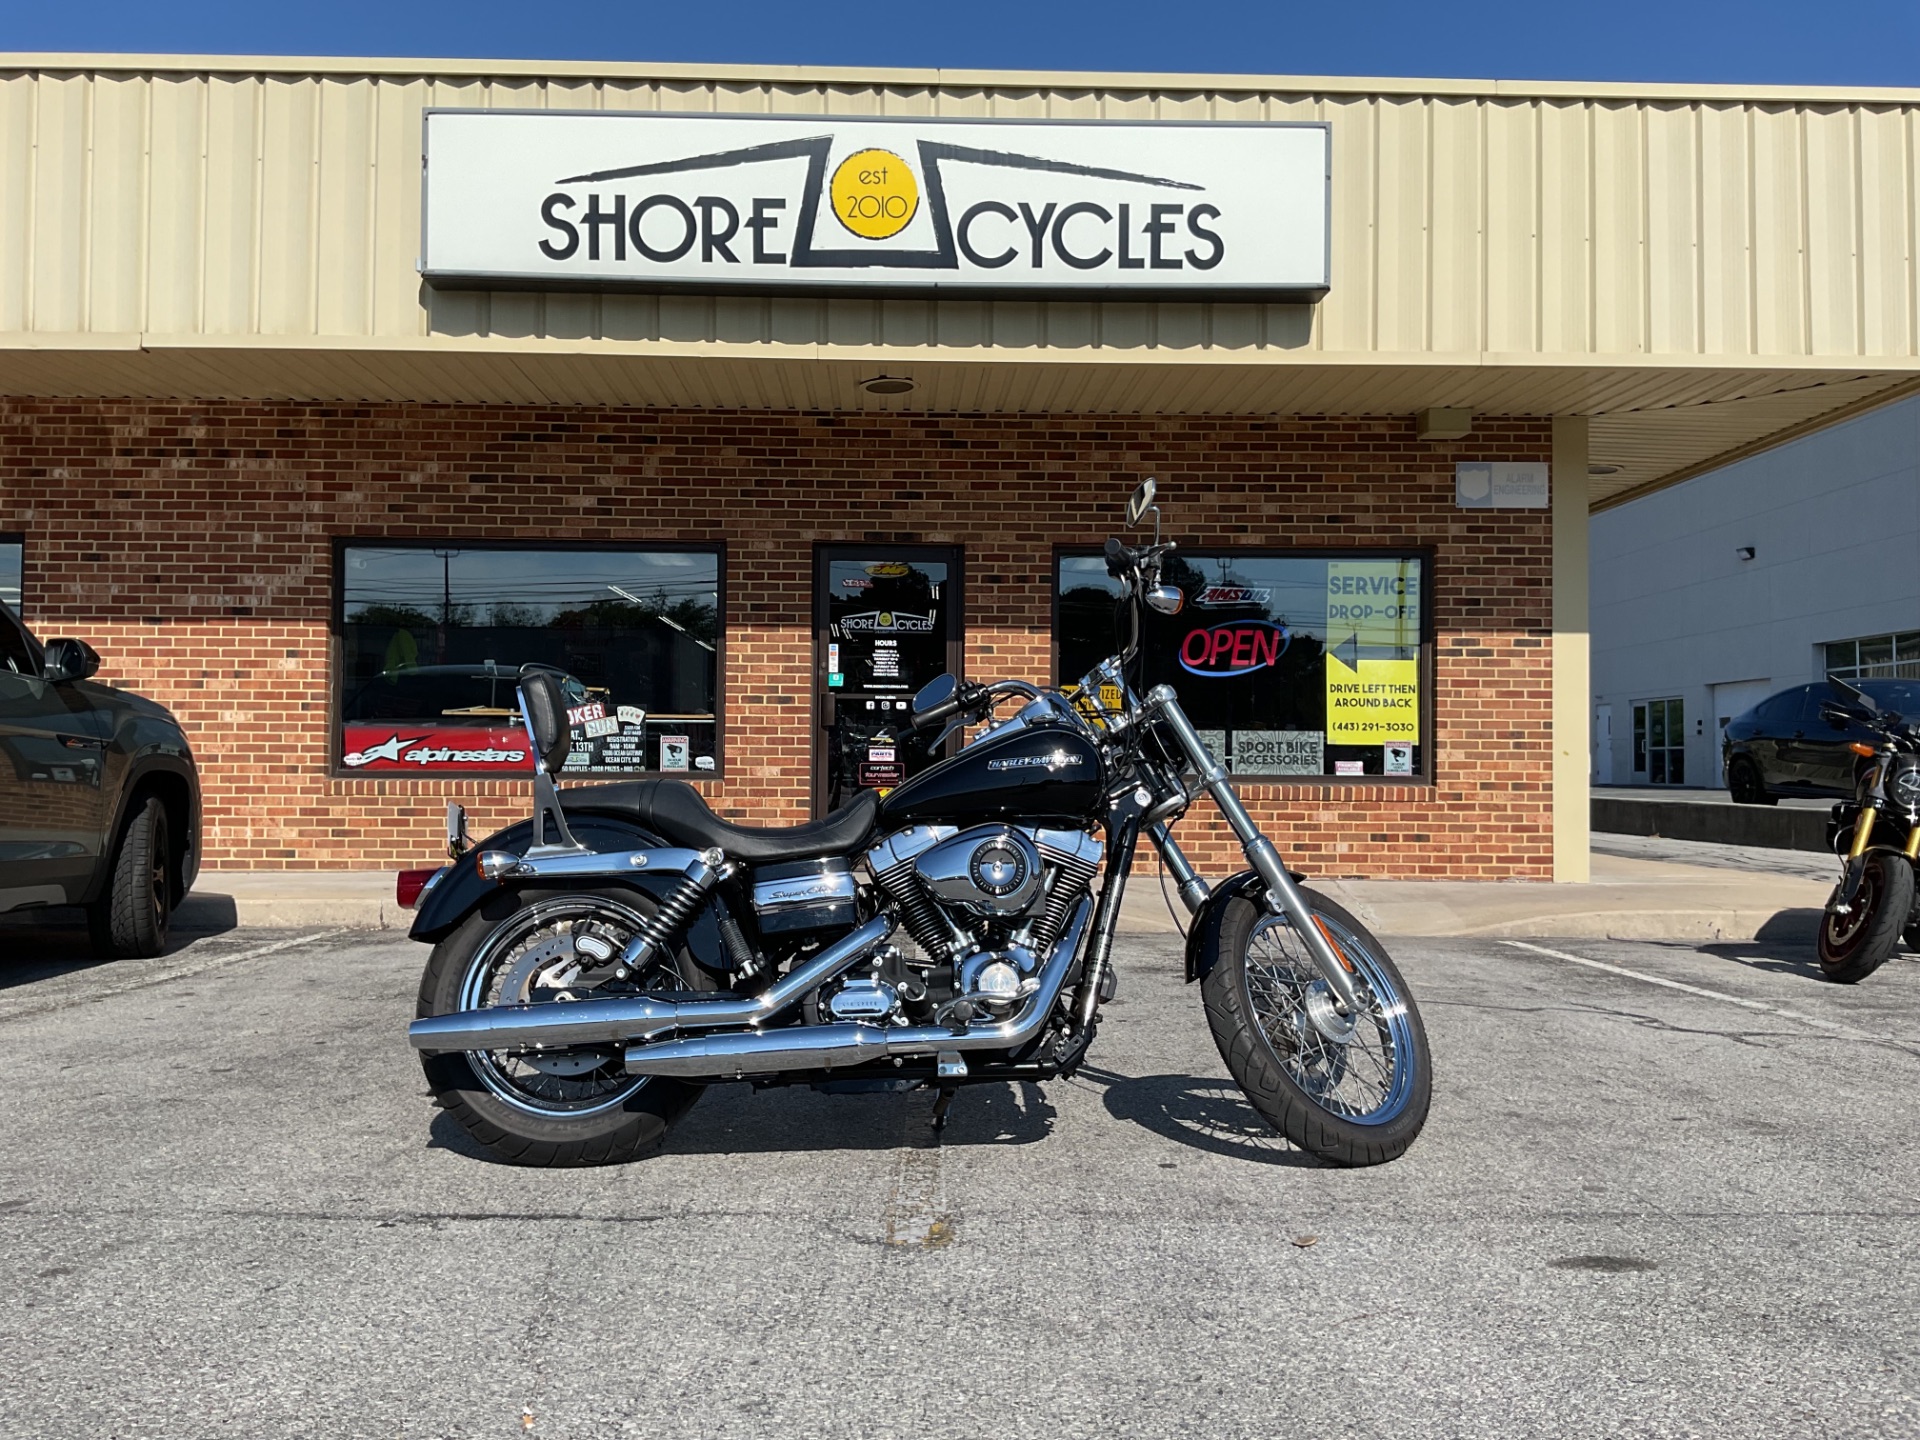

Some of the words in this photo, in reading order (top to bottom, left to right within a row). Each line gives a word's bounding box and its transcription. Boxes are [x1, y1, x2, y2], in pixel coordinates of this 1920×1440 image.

[858, 167, 887, 185] est
[847, 195, 908, 219] 2010
[538, 192, 787, 264] SHORE
[956, 201, 1225, 270] CYCLES
[1505, 473, 1534, 484] ALARM
[1493, 484, 1546, 495] ENGINEERING
[1329, 576, 1418, 595] SERVICE
[1202, 588, 1269, 601] AMSOIL
[1329, 604, 1417, 619] DROP-OFF
[841, 619, 874, 629] SHORE
[897, 620, 933, 630] CYCLES
[1182, 629, 1280, 666] OPEN
[1330, 684, 1360, 693] DRIVE
[1362, 684, 1387, 693] LEFT
[1388, 684, 1416, 694] THEN
[1335, 698, 1381, 707] AROUND
[1383, 698, 1412, 708] BACK
[566, 704, 604, 725] KER
[586, 716, 618, 737] RUN
[1332, 722, 1360, 731] (443)
[1361, 722, 1414, 732] 291-3030
[575, 742, 594, 752] 13TH
[1238, 742, 1283, 753] SPORT
[1286, 742, 1318, 754] BIKE
[404, 747, 525, 764] alpinestars
[991, 755, 1080, 768] HARLEY-DAVION
[1238, 755, 1318, 765] ACCESSORIES
